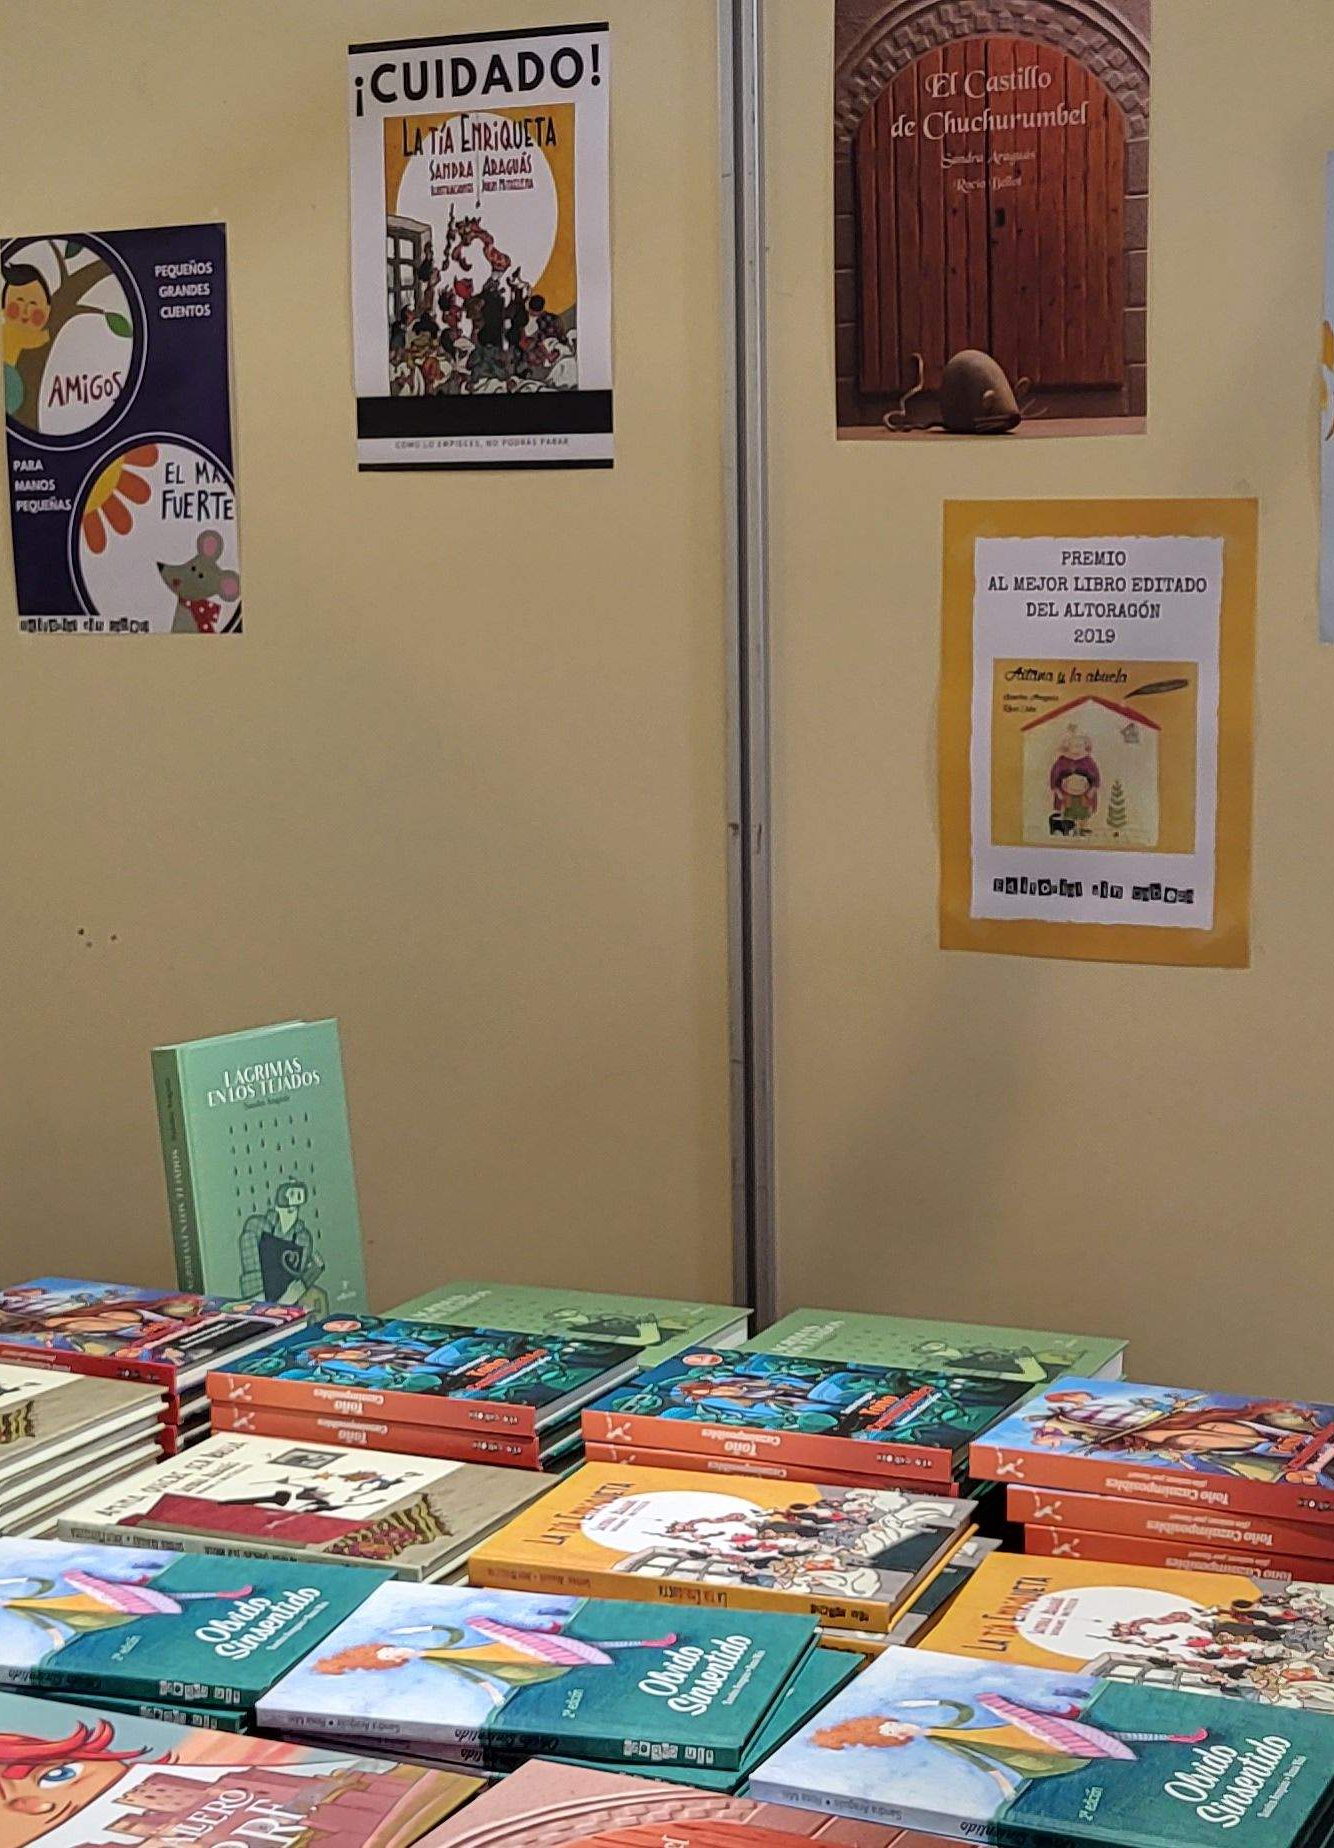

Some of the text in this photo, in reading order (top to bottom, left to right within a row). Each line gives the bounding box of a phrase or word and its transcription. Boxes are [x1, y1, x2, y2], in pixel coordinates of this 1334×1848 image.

[355, 44, 601, 117] ¡CUIDADO!
[925, 66, 1052, 98] El Castillo
[890, 102, 1090, 140] de Chuchurumbel
[403, 114, 556, 157] LA TÍA ENRIQUETA
[429, 151, 532, 180] SANDRA ARAGUÁS
[155, 260, 213, 278] PEQUEÑOS
[159, 284, 210, 298] GRANDES
[161, 305, 211, 319] CUENTOS
[13, 460, 43, 473] PARA
[165, 462, 186, 484] EL
[15, 479, 55, 492] MANOS
[16, 497, 72, 513] PEQUEÑAS
[162, 490, 235, 521] FUERTE
[1061, 550, 1126, 567] PREMIO
[988, 577, 1207, 593] AL MEJOR LIBRO EDITADO
[1026, 600, 1161, 619] DEL ALTORAGÓN
[1074, 629, 1115, 644] 2019
[1057, 671, 1065, 684] y
[1069, 667, 1082, 683] la
[1086, 669, 1128, 683] abuela
[724, 1440, 756, 1457] Toño
[195, 1597, 271, 1642] Olvido
[215, 1588, 321, 1660] Sinsentido
[638, 1646, 704, 1696] Olvido
[667, 1635, 752, 1716] Sinsentido
[1164, 1745, 1238, 1802] Olvido
[1197, 1735, 1291, 1828] Sinsentido
